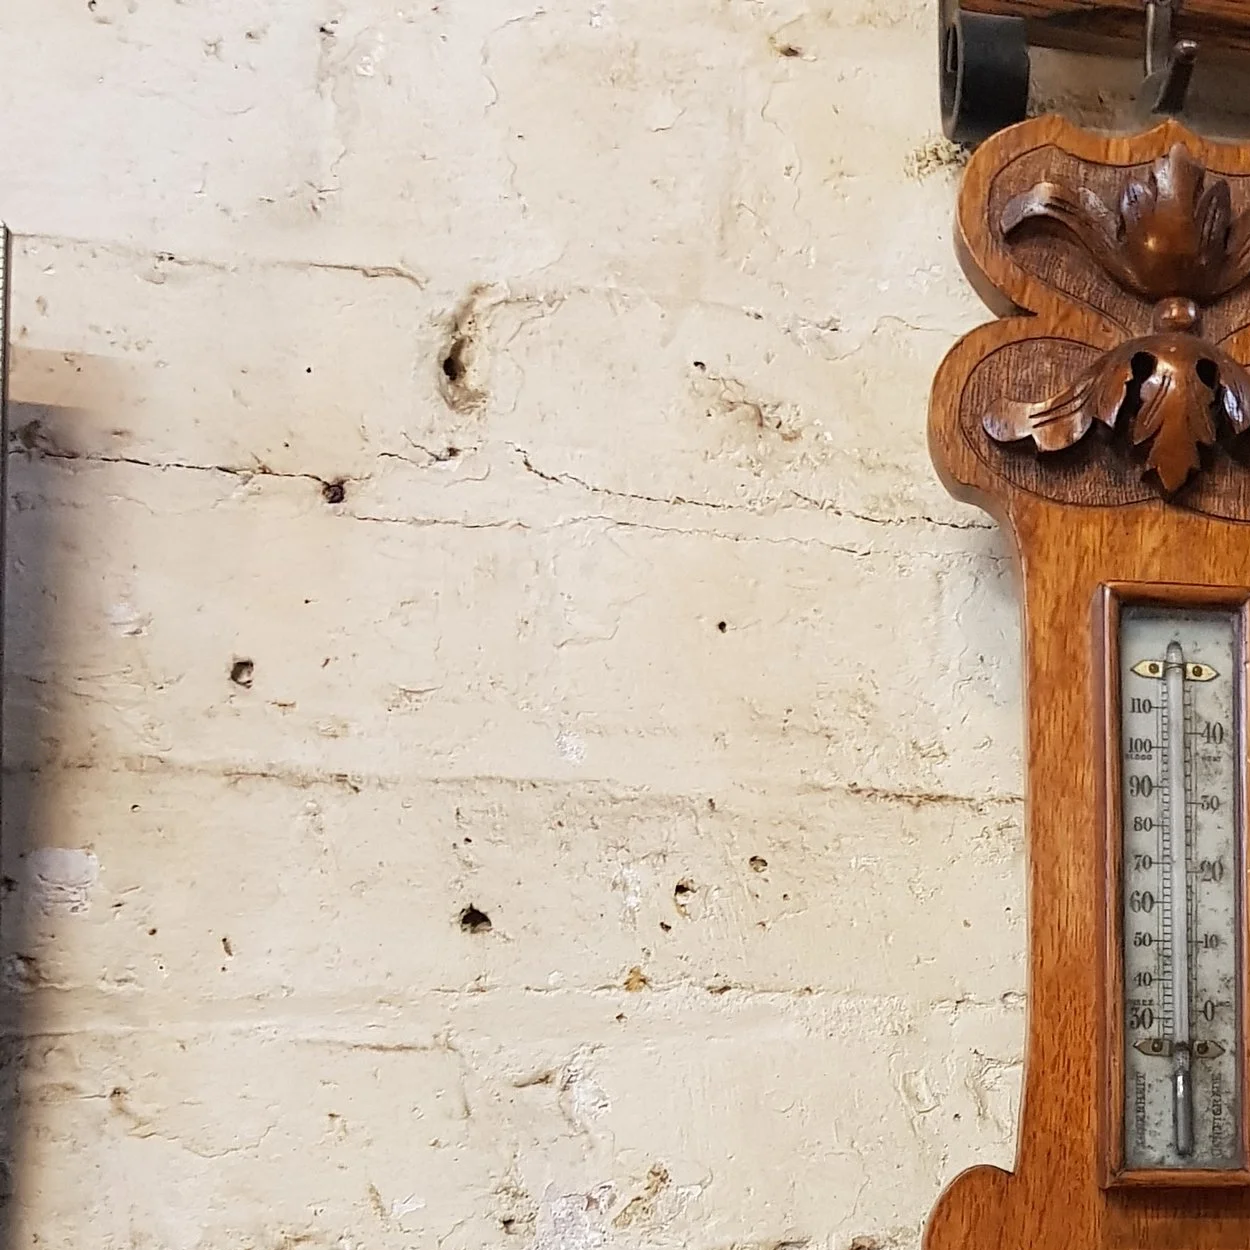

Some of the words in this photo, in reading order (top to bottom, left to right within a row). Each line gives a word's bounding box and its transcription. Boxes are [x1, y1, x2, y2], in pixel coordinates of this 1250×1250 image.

[1130, 697, 1152, 714] 110
[1201, 721, 1224, 745] 40
[1128, 737, 1152, 754] 100
[1129, 775, 1152, 798] 90
[1133, 816, 1152, 832] 80
[1134, 854, 1152, 871] 70
[1200, 859, 1224, 882] 20
[1129, 890, 1153, 913] 60
[1133, 932, 1152, 947] 50
[1202, 933, 1219, 949] 10
[1133, 972, 1152, 987] 40
[1129, 1006, 1153, 1030] 30
[1203, 1000, 1216, 1022] 0
